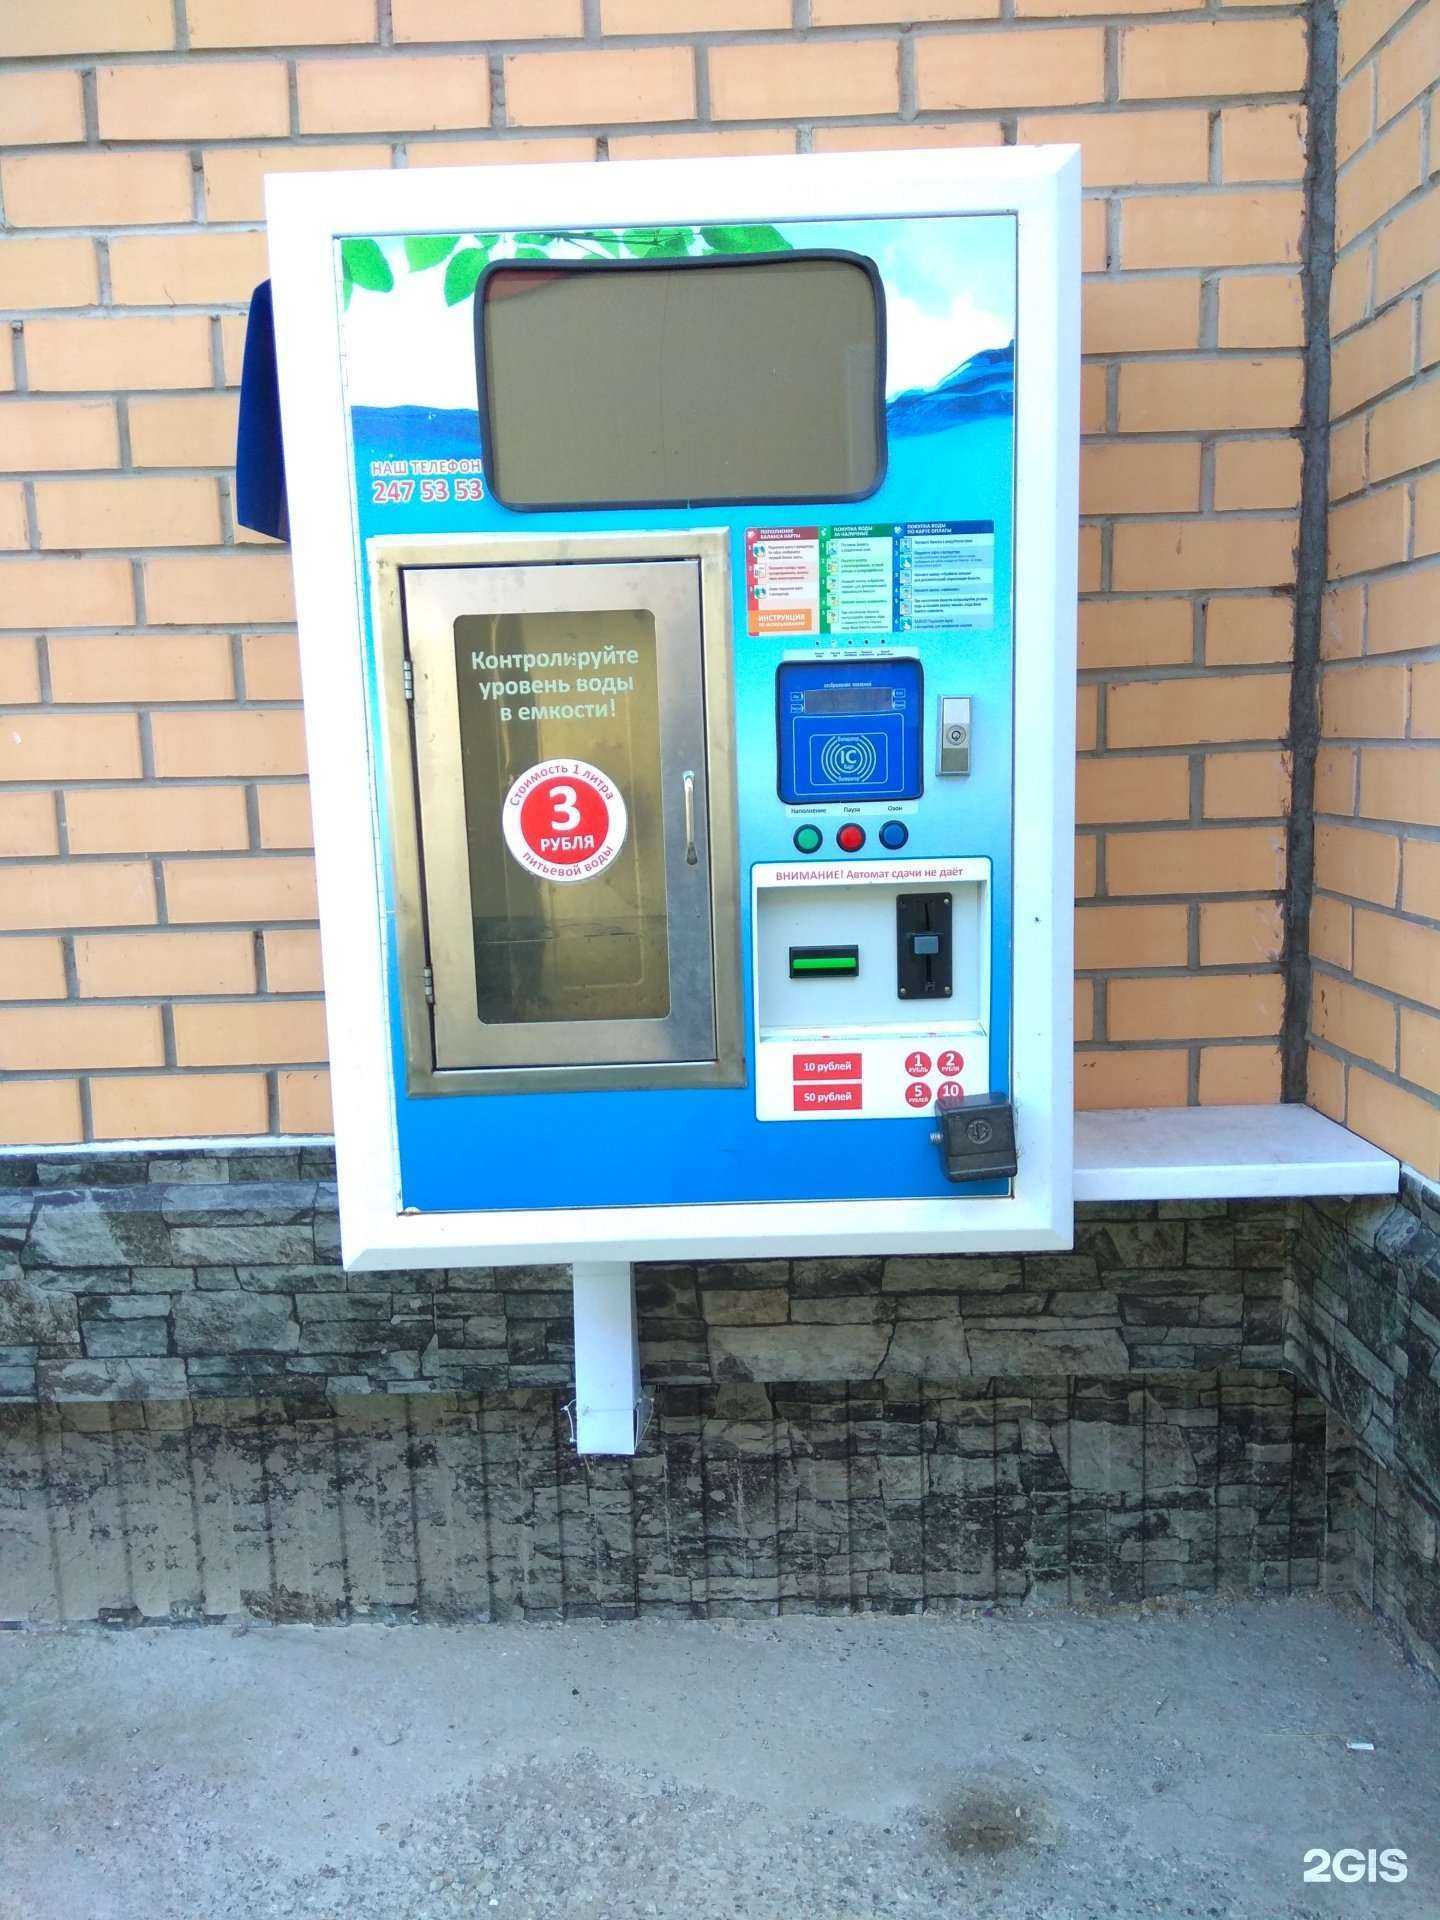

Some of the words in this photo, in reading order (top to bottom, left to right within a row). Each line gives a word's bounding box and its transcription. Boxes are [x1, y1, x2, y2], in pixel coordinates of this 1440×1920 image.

[372, 461, 407, 474] НАШ
[412, 460, 481, 473] ТЕЛЕФОН
[374, 481, 413, 502] 247
[421, 481, 448, 501] 53
[455, 480, 482, 500] 53
[479, 679, 571, 700] уровень
[575, 675, 634, 696] воды
[500, 708, 512, 721] в
[518, 698, 616, 720] емкости!
[510, 765, 568, 806] Стоимость
[573, 764, 579, 774] 1
[582, 770, 614, 800] литра
[549, 785, 581, 832] 3
[540, 834, 595, 852] РУБЛЯ
[522, 852, 582, 877] питьевой
[584, 845, 614, 872] воды
[776, 869, 843, 880] ВНИМАНИЕ!
[846, 870, 889, 880] Автомат
[892, 869, 922, 881] сдачи
[924, 868, 937, 877] не
[939, 868, 963, 878] даёт
[803, 1062, 815, 1072] 10
[817, 1060, 852, 1073] рублей
[914, 1054, 922, 1066] 1
[945, 1053, 956, 1066] 2
[804, 1092, 816, 1101] 50
[818, 1090, 852, 1103] рублей
[914, 1085, 922, 1097] 5
[943, 1084, 960, 1096] 10
